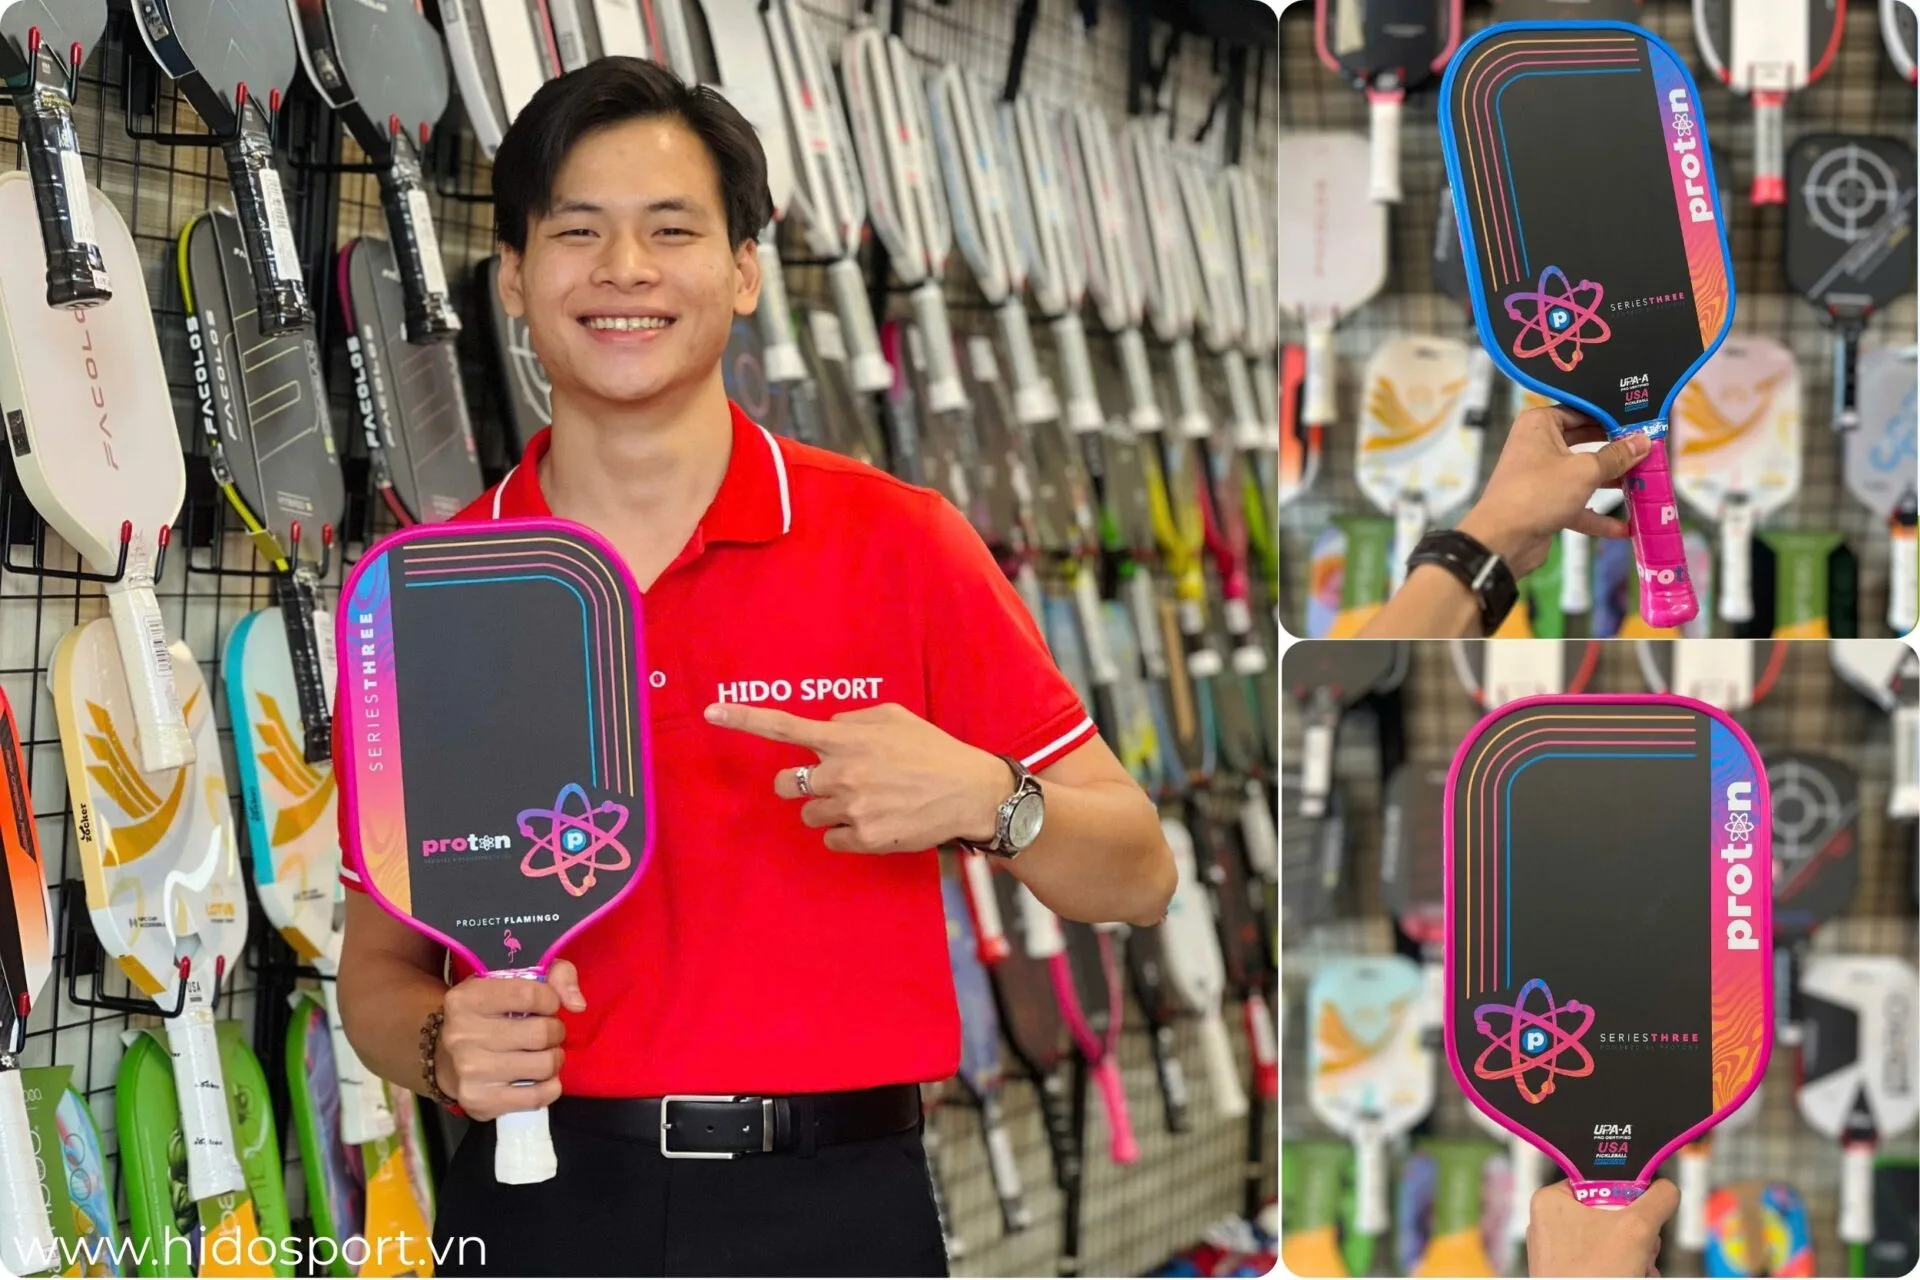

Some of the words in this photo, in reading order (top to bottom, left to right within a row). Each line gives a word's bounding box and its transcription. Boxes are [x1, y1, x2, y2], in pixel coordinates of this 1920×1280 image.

[186, 316, 218, 435] FACOLOS
[206, 309, 237, 440] FACOLOS
[1620, 373, 1649, 388] UPA-A
[74, 308, 119, 471] FACOLO
[346, 336, 380, 448] FACOLOS
[1625, 388, 1649, 402] USA
[717, 679, 793, 704] HIDO
[800, 677, 884, 701] SPORT
[456, 916, 501, 928] PROJECT
[504, 913, 560, 925] FLAMINGO
[1593, 1124, 1632, 1135] UPA-A
[1598, 1141, 1629, 1153] USA
